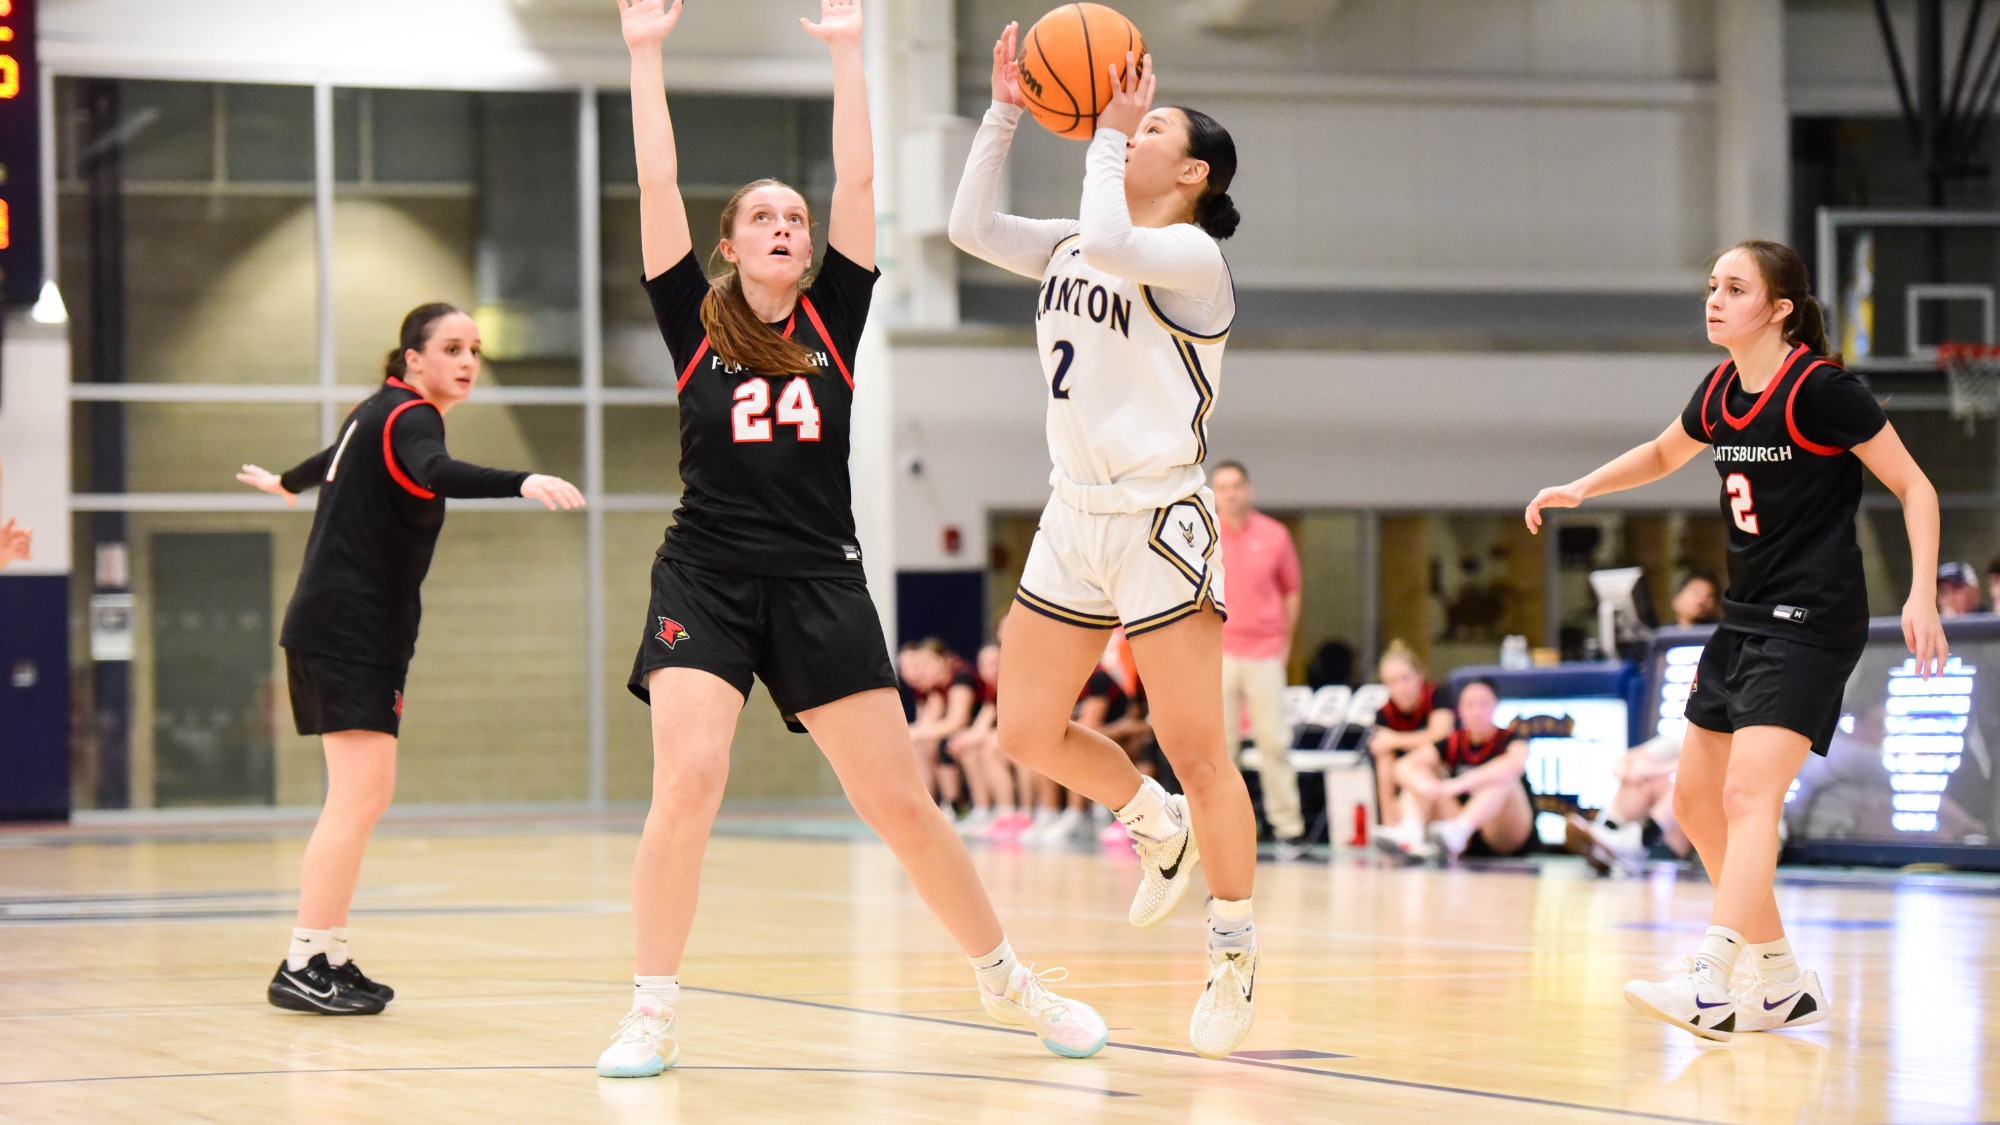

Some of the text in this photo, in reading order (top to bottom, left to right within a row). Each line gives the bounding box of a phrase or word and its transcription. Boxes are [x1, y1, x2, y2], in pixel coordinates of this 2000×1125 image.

[1036, 275, 1132, 340] ANTON
[1050, 339, 1075, 400] 2
[731, 376, 821, 443] 24
[1726, 473, 1760, 536] 2
